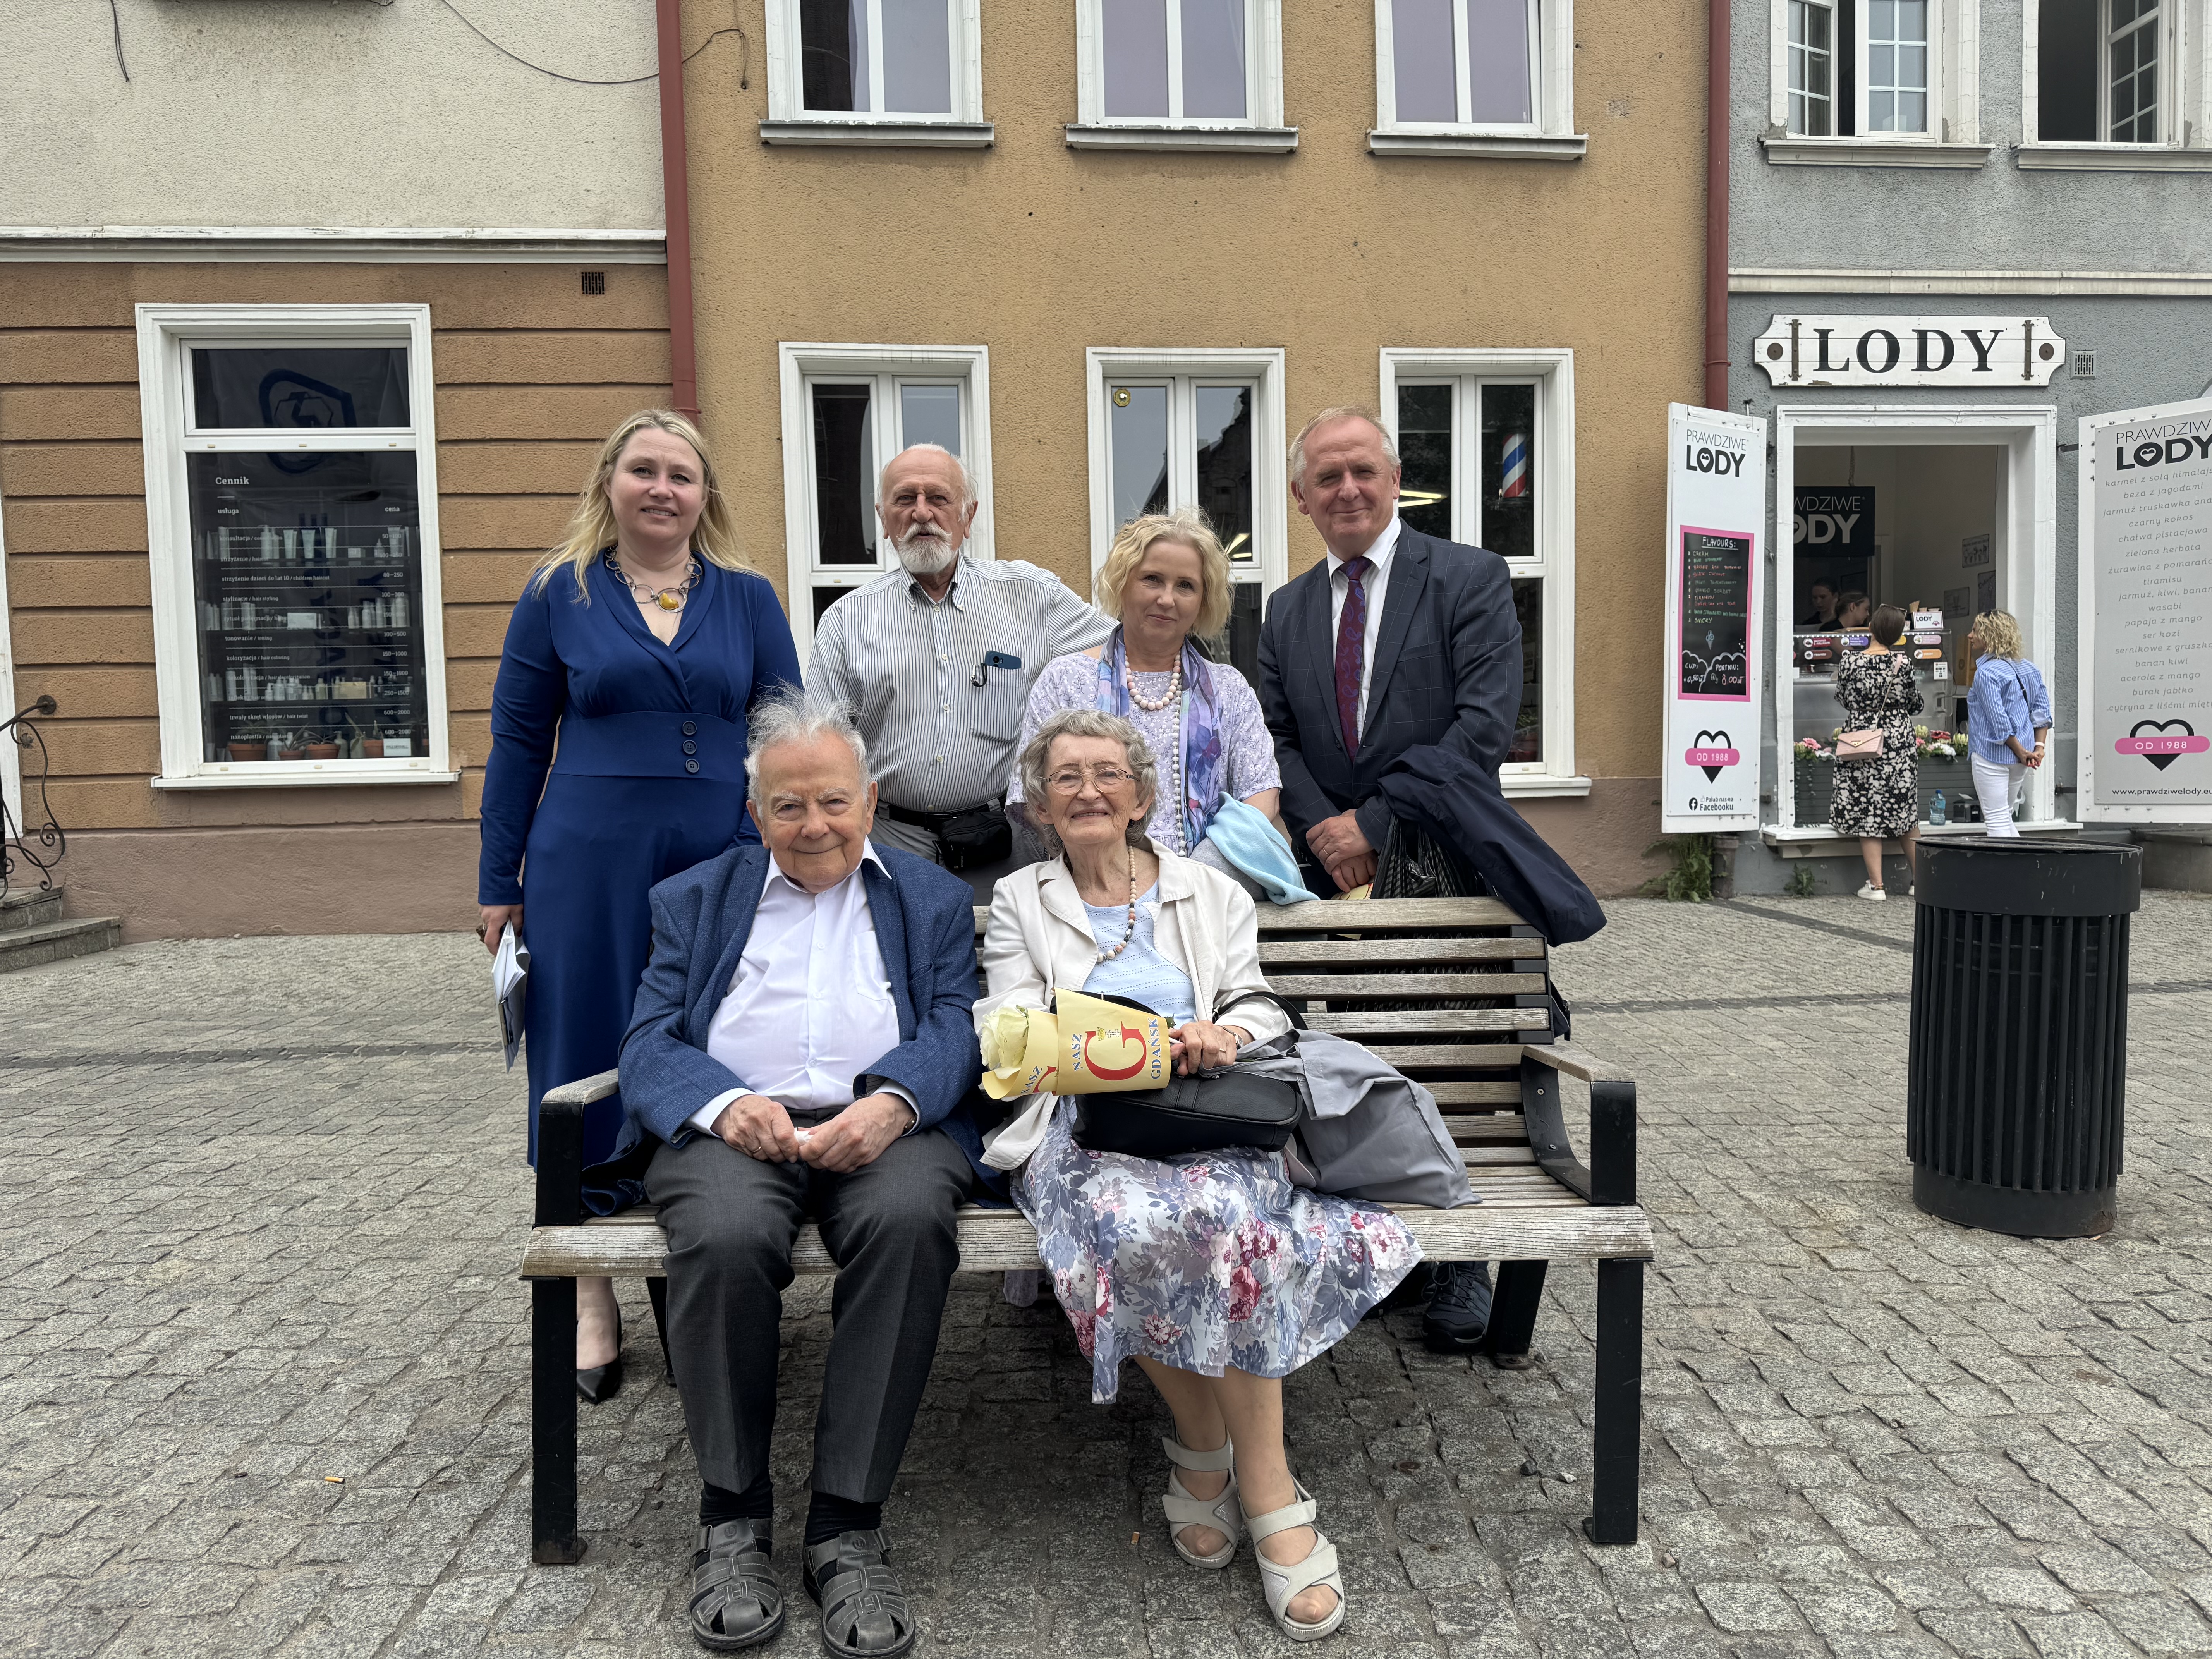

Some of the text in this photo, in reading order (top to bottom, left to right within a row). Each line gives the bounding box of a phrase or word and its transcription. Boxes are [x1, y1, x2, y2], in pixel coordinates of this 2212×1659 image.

[1813, 328, 2004, 373] LODY
[1687, 429, 1747, 451] PRAWDZIWE
[2116, 433, 2212, 471] LODY
[1686, 445, 1746, 477] LODY
[215, 476, 249, 485] Cennik
[2106, 477, 2137, 487] karmel
[2158, 482, 2203, 496] jagodami
[2103, 507, 2136, 518] jarmuż
[2139, 500, 2190, 511] truskawka
[2129, 515, 2193, 527] czarny kokos
[2119, 527, 2208, 542] chałwa pistacjowa
[1702, 536, 1736, 549] FLAVOURS:
[2125, 544, 2200, 557] zielona herbata
[2108, 564, 2151, 574] żurawina
[2143, 576, 2182, 585] tiramisu
[2148, 602, 2182, 611] wasabi
[2125, 618, 2157, 628] papaja
[2159, 630, 2180, 638] kozi
[2116, 645, 2163, 654] sernikowe
[2168, 672, 2201, 680] mango
[2163, 687, 2193, 696] jabłko
[2189, 700, 2212, 709] mięt
[2161, 741, 2187, 750] 1988
[1697, 752, 1729, 761] OD 1988
[1700, 803, 1733, 811] Facebooku
[1071, 1033, 1083, 1072] NASZ
[1084, 1021, 1148, 1081] G
[1147, 1017, 1162, 1080] GDAŃSK
[1020, 1065, 1043, 1094] NASZ
